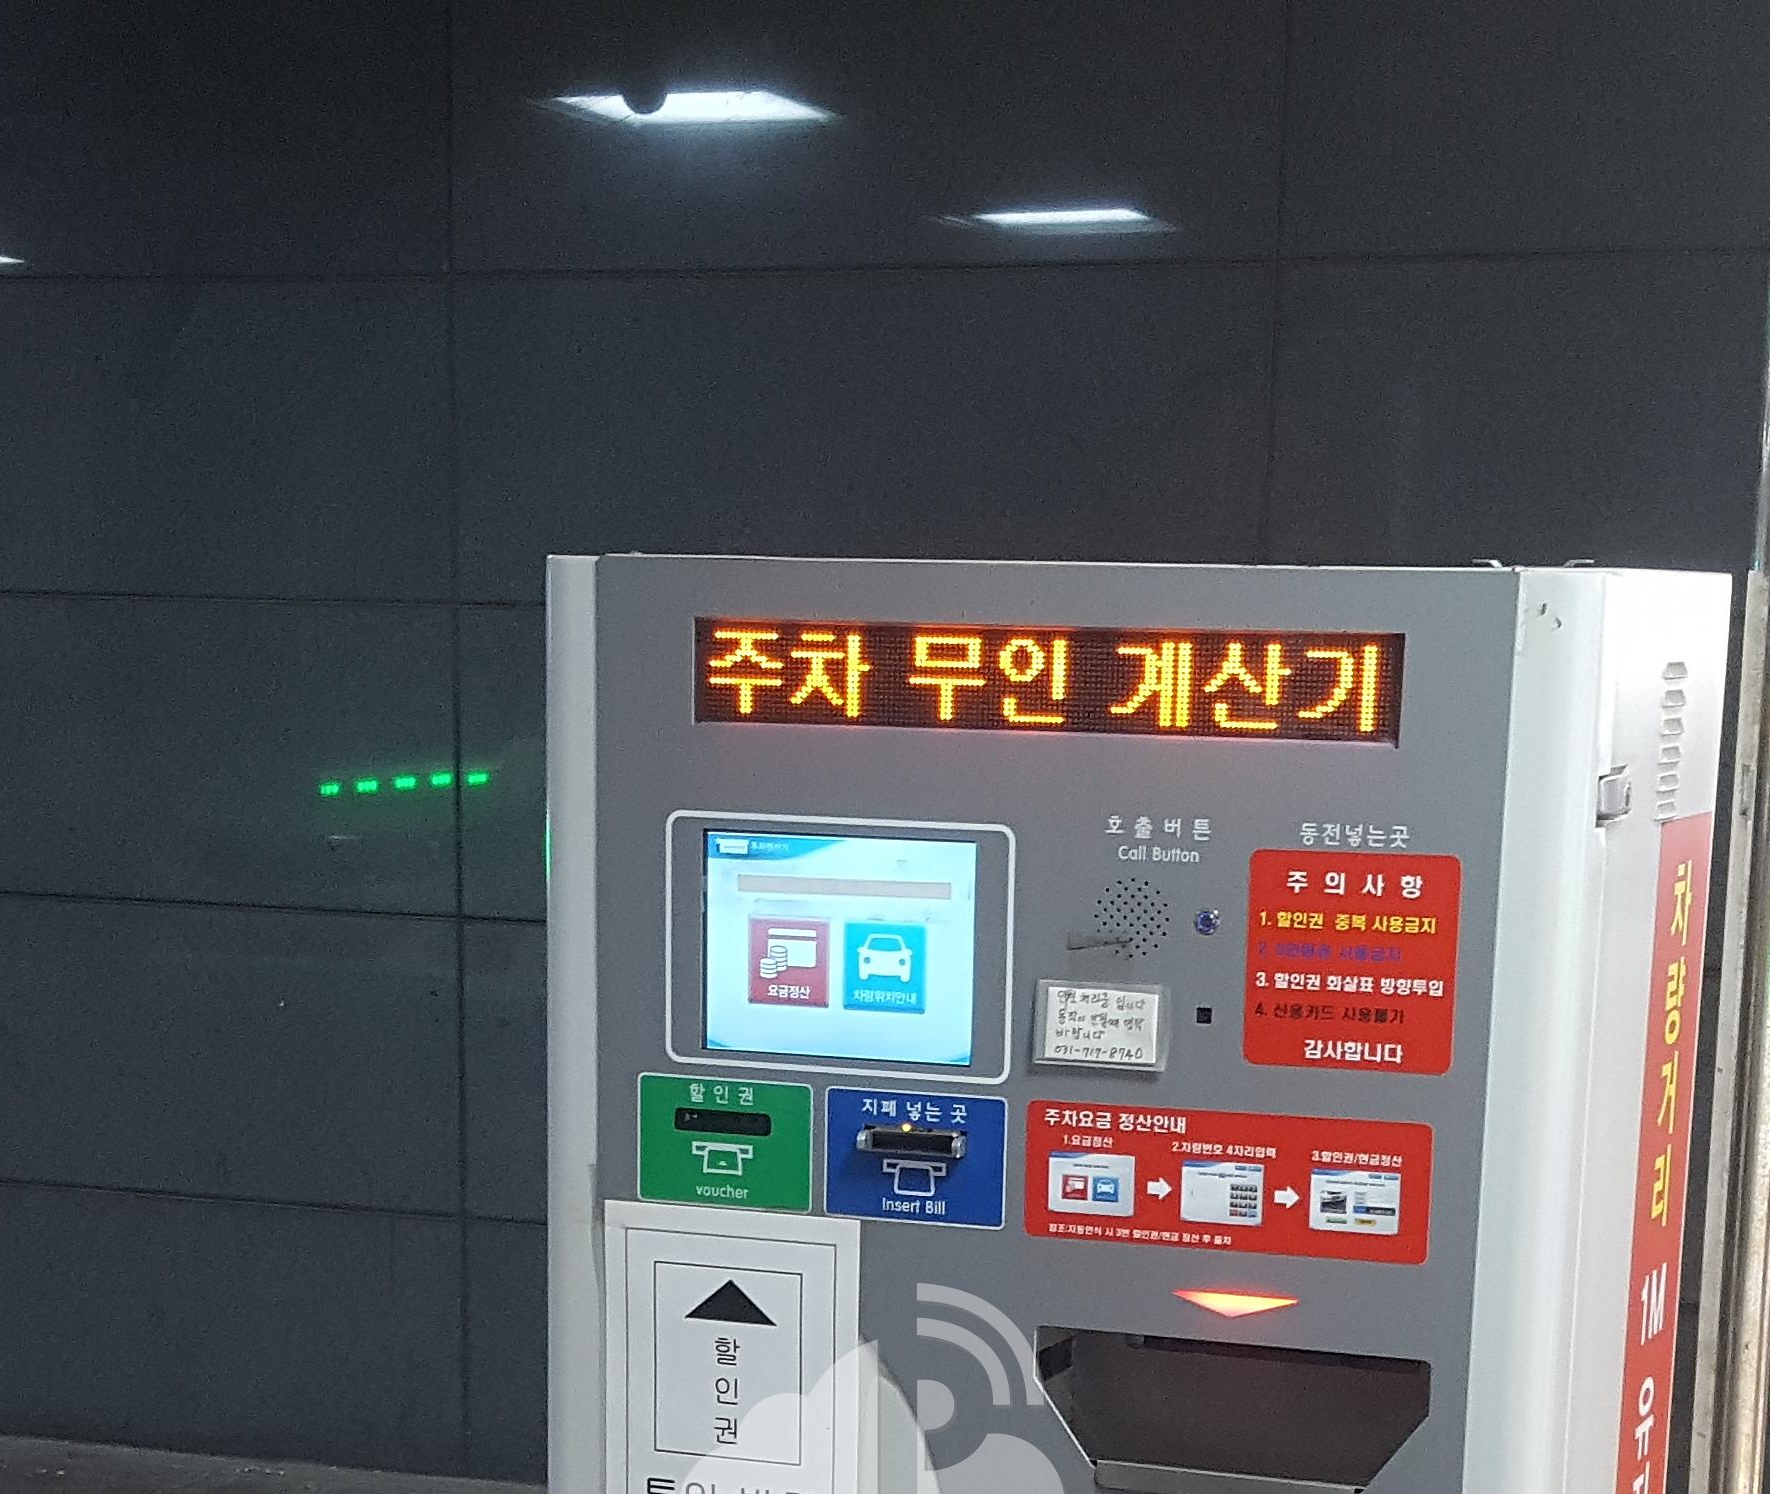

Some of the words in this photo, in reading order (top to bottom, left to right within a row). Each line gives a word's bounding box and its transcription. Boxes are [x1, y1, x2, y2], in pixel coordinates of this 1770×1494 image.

[707, 628, 872, 718] 주차
[909, 634, 1069, 724] 무인
[1109, 641, 1379, 733] 계산기
[1299, 822, 1411, 849] 동전넣는곳
[1118, 845, 1147, 862] Call
[1152, 848, 1200, 864] Button
[1277, 911, 1324, 929] 할인권
[1371, 915, 1437, 935] 사용금지
[766, 984, 811, 1000] 요금정산
[1274, 972, 1321, 991] 할인권
[1326, 975, 1374, 993] 화살표
[1380, 978, 1445, 997] 방향투입
[1273, 1002, 1335, 1021] 신용카드
[1055, 1026, 1106, 1040] 바랍니다
[1650, 859, 1694, 1228] 차량거리
[1303, 1039, 1404, 1064] 감사합니다
[689, 1082, 755, 1106] 할인권
[861, 1098, 898, 1118] 지폐
[904, 1101, 942, 1123] 넣는
[949, 1104, 968, 1124] 곳
[1043, 1107, 1112, 1130] 주차요금
[1118, 1112, 1188, 1135] 정산안내
[695, 1183, 750, 1200] voucher
[881, 1197, 921, 1214] Insert
[924, 1200, 947, 1216] Bill
[1640, 1262, 1669, 1346] 1M
[714, 1336, 741, 1446] 할인권
